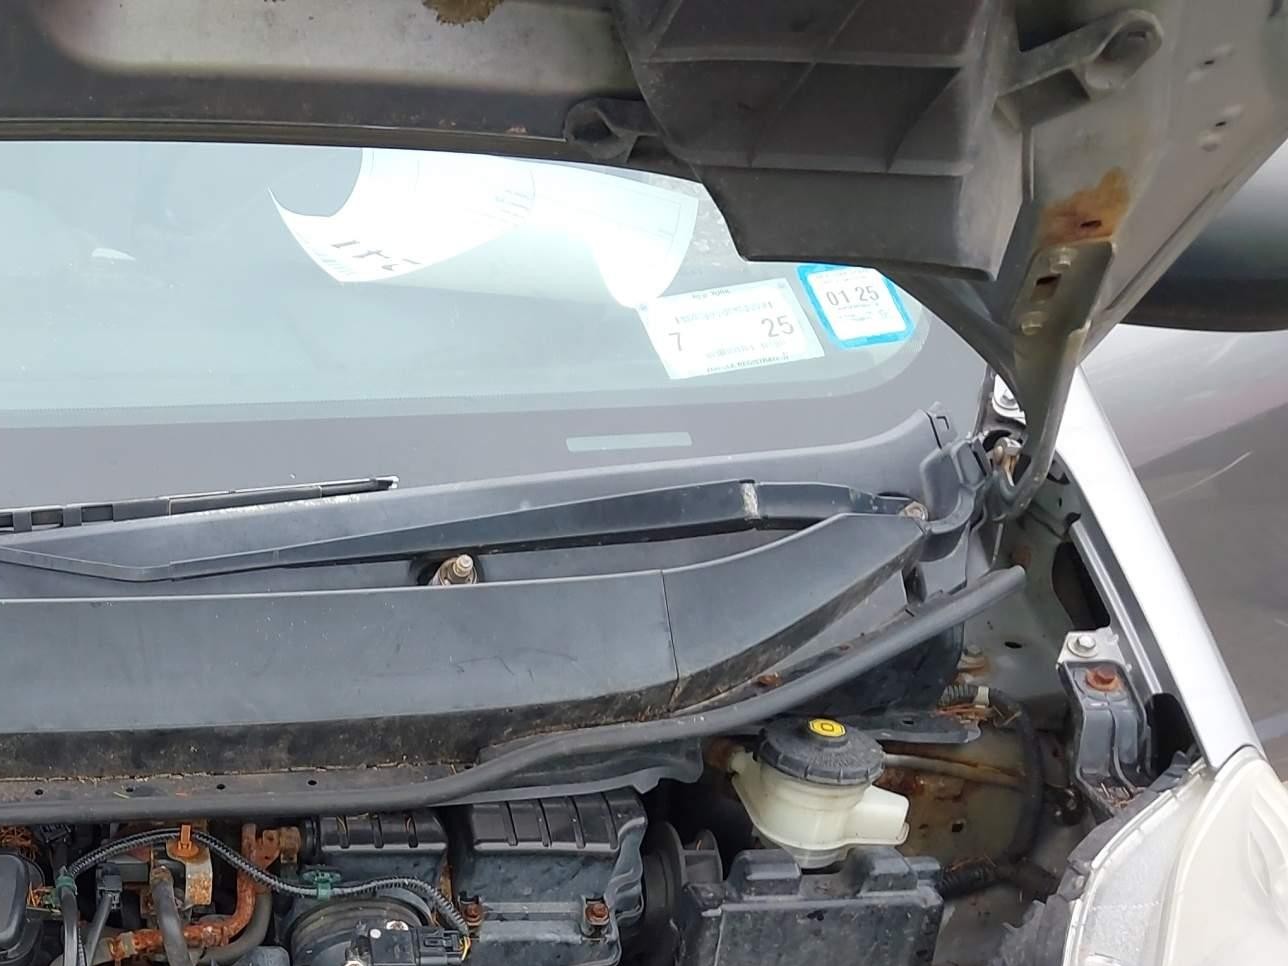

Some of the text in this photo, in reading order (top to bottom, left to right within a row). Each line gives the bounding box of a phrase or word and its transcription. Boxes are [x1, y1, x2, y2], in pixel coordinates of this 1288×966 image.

[826, 285, 879, 306] 01 25
[761, 314, 795, 338] 25
[668, 332, 683, 352] 7
